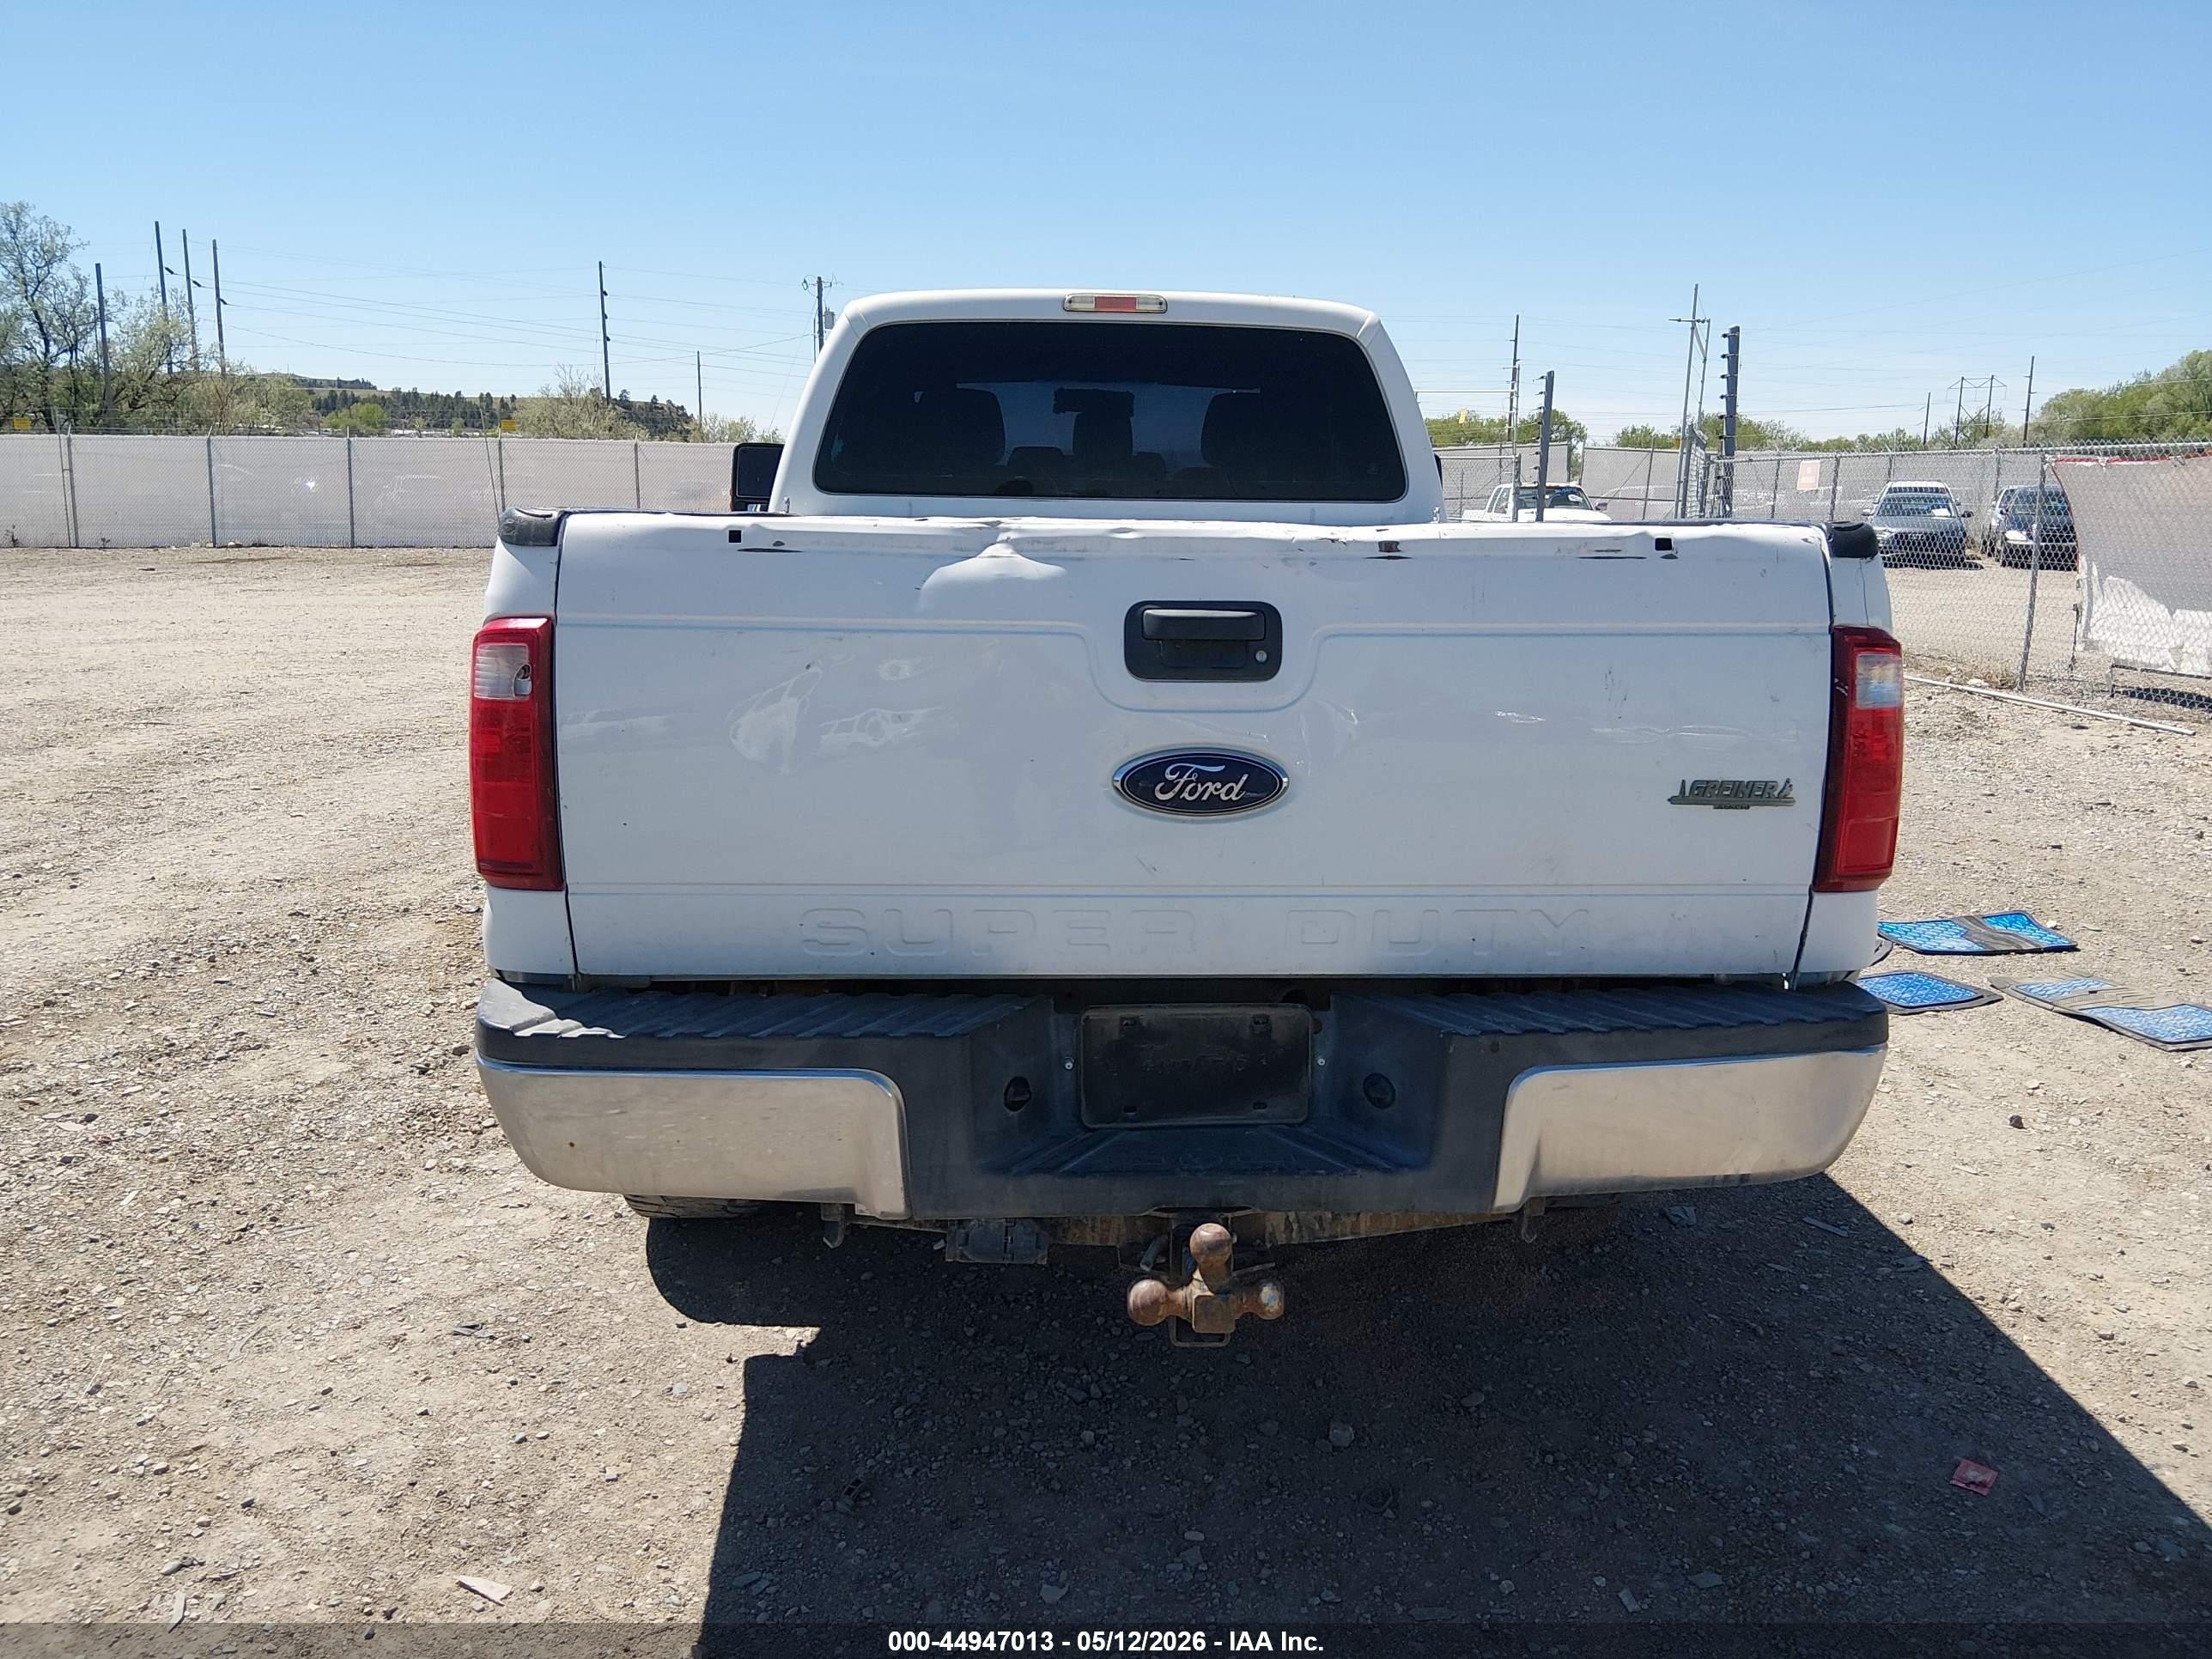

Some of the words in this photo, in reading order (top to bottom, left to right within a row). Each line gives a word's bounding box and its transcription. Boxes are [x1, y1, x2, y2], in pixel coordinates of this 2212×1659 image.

[1154, 763, 1249, 801] Ford
[1688, 779, 1779, 799] GREINER
[799, 907, 1197, 957] SUPER
[1285, 908, 1590, 957] DUTY
